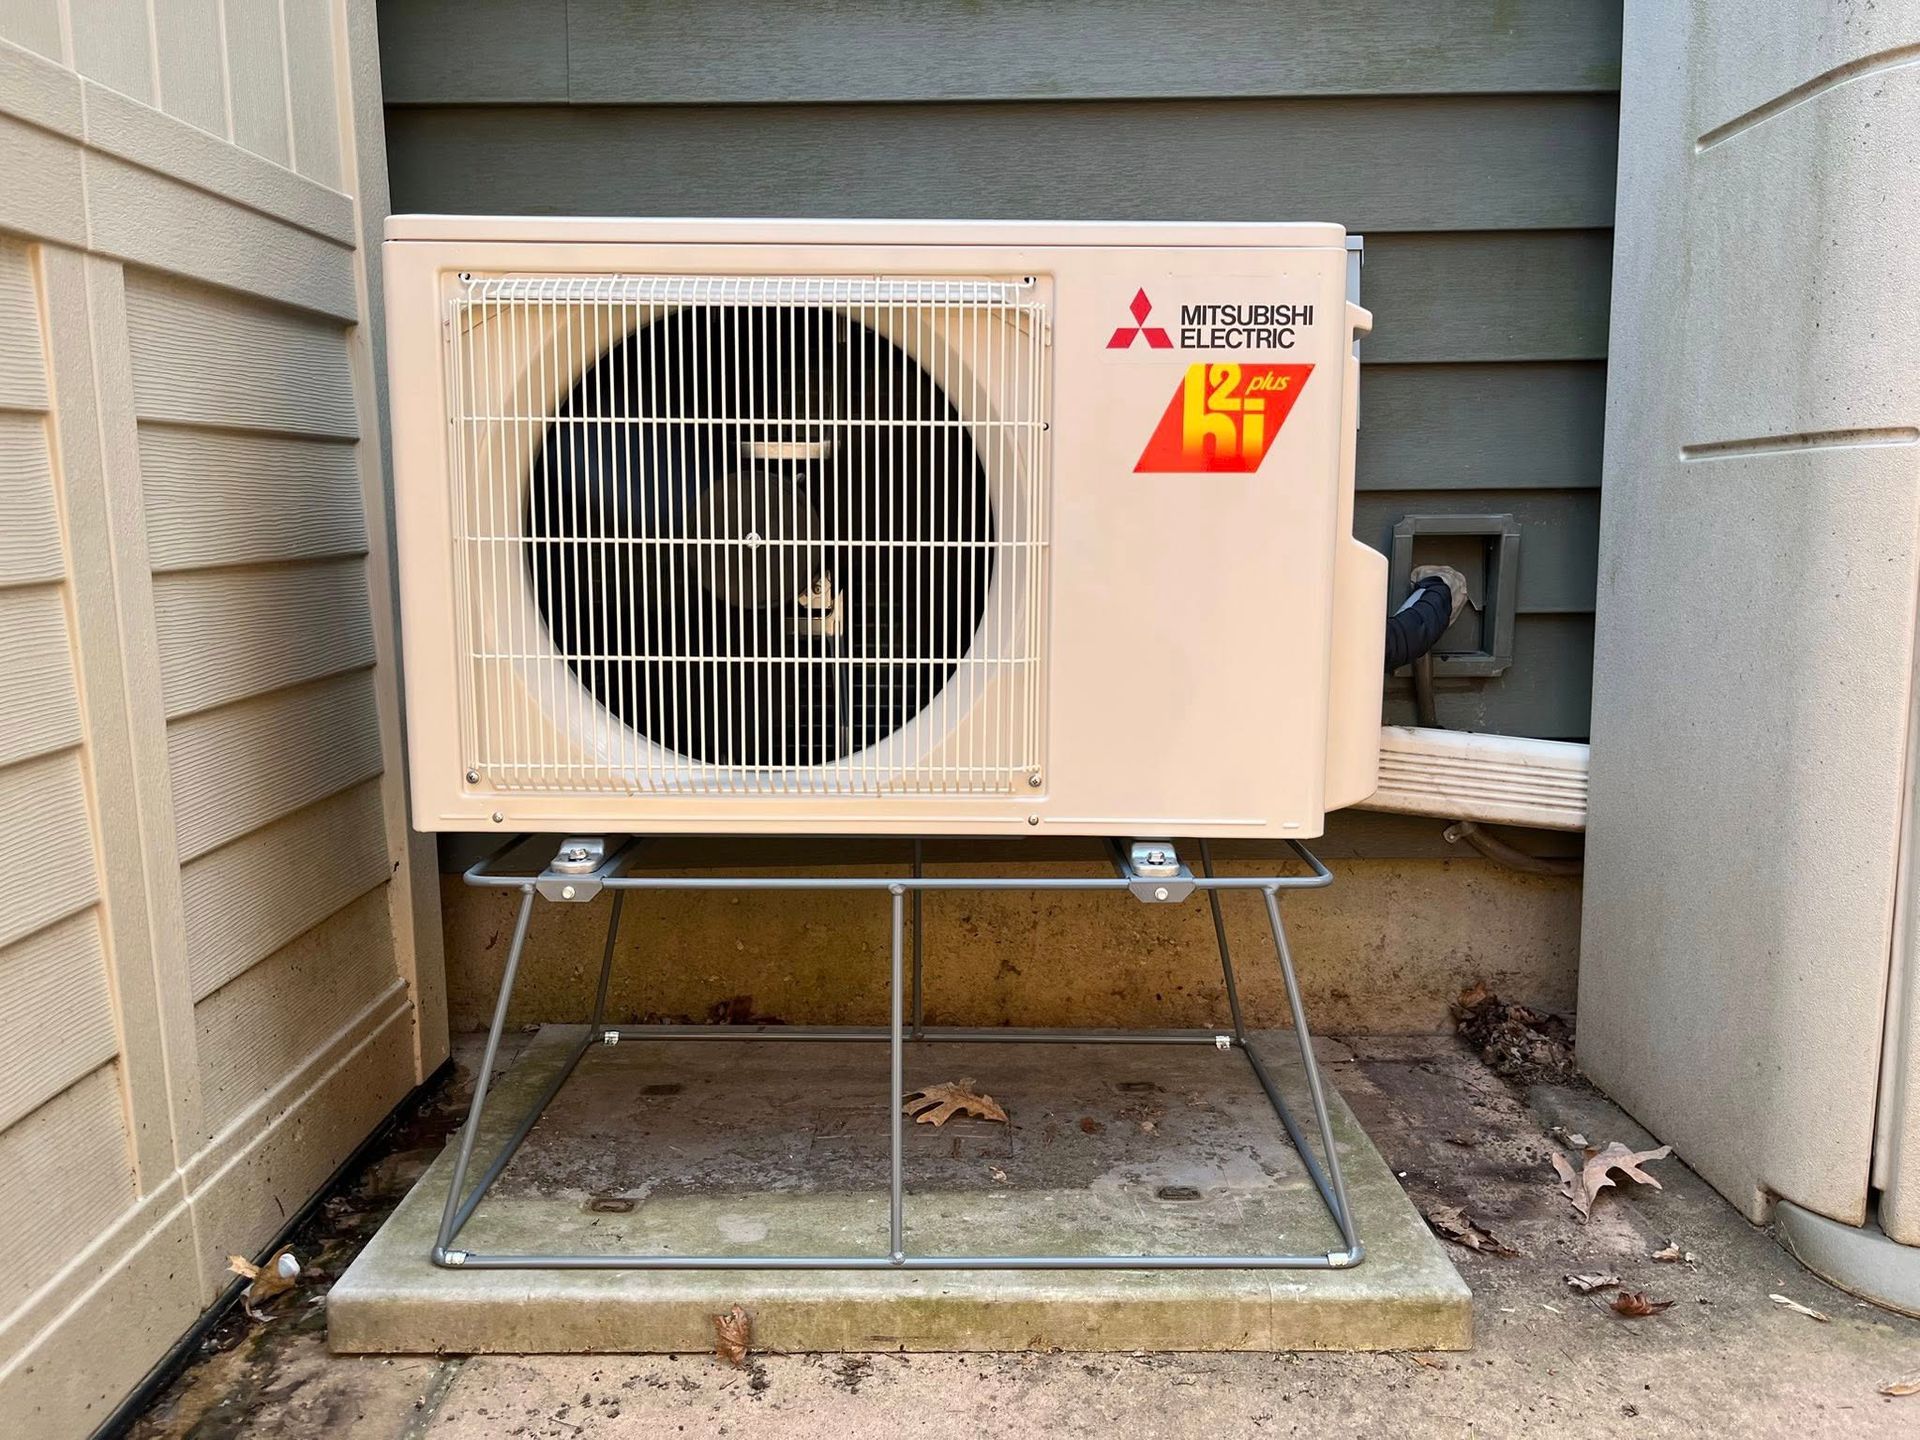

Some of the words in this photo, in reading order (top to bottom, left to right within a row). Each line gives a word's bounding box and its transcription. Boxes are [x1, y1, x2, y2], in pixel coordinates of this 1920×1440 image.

[1180, 304, 1314, 326] MITSUBISHI
[1180, 328, 1296, 349] ELECTRIC
[1246, 371, 1290, 394] plus
